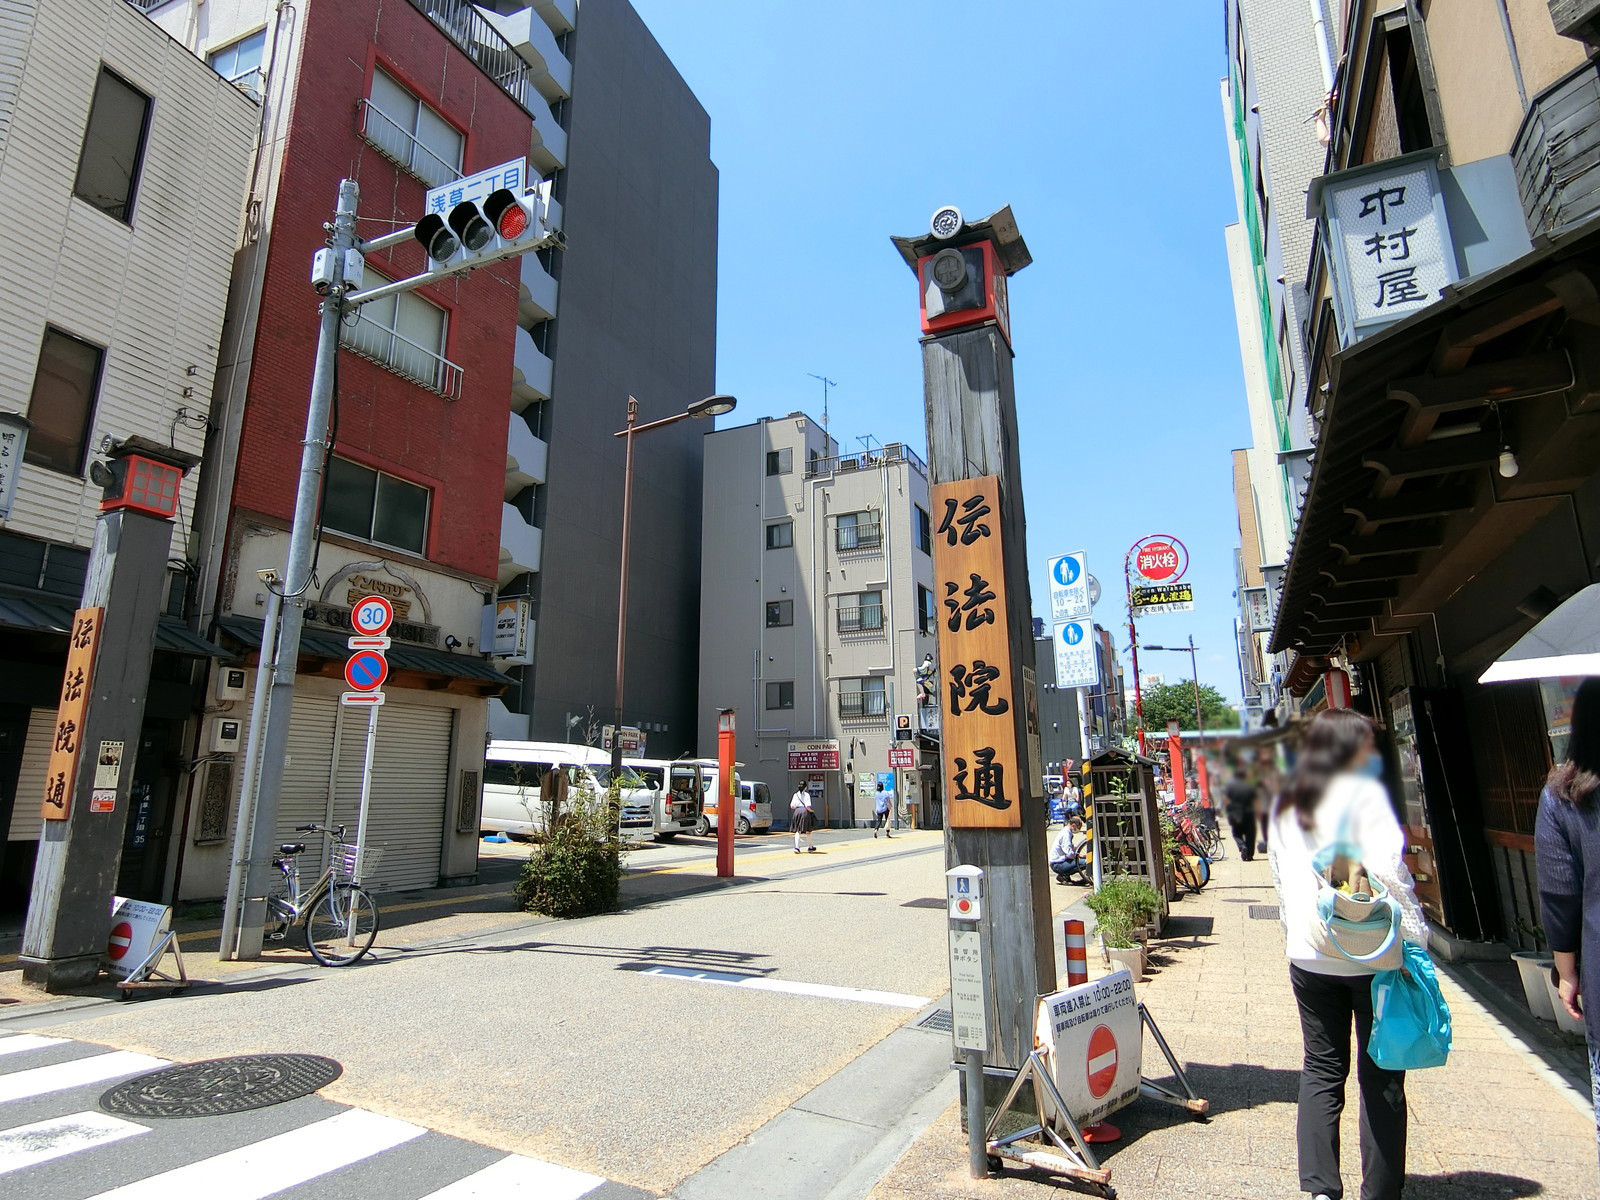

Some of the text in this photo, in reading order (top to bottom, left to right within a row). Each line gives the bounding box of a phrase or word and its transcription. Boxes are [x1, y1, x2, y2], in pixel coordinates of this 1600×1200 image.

[431, 167, 519, 214] 浅草二丁目
[1358, 186, 1428, 308] 中村屋
[1140, 551, 1176, 570] 消火栓
[347, 574, 411, 597] インドカリー
[361, 607, 384, 625] 30
[937, 494, 1011, 810] 伝法院通
[46, 618, 93, 809] 伝法院通
[1053, 979, 1131, 1017] 車両進入禁止 10:00-22:00
